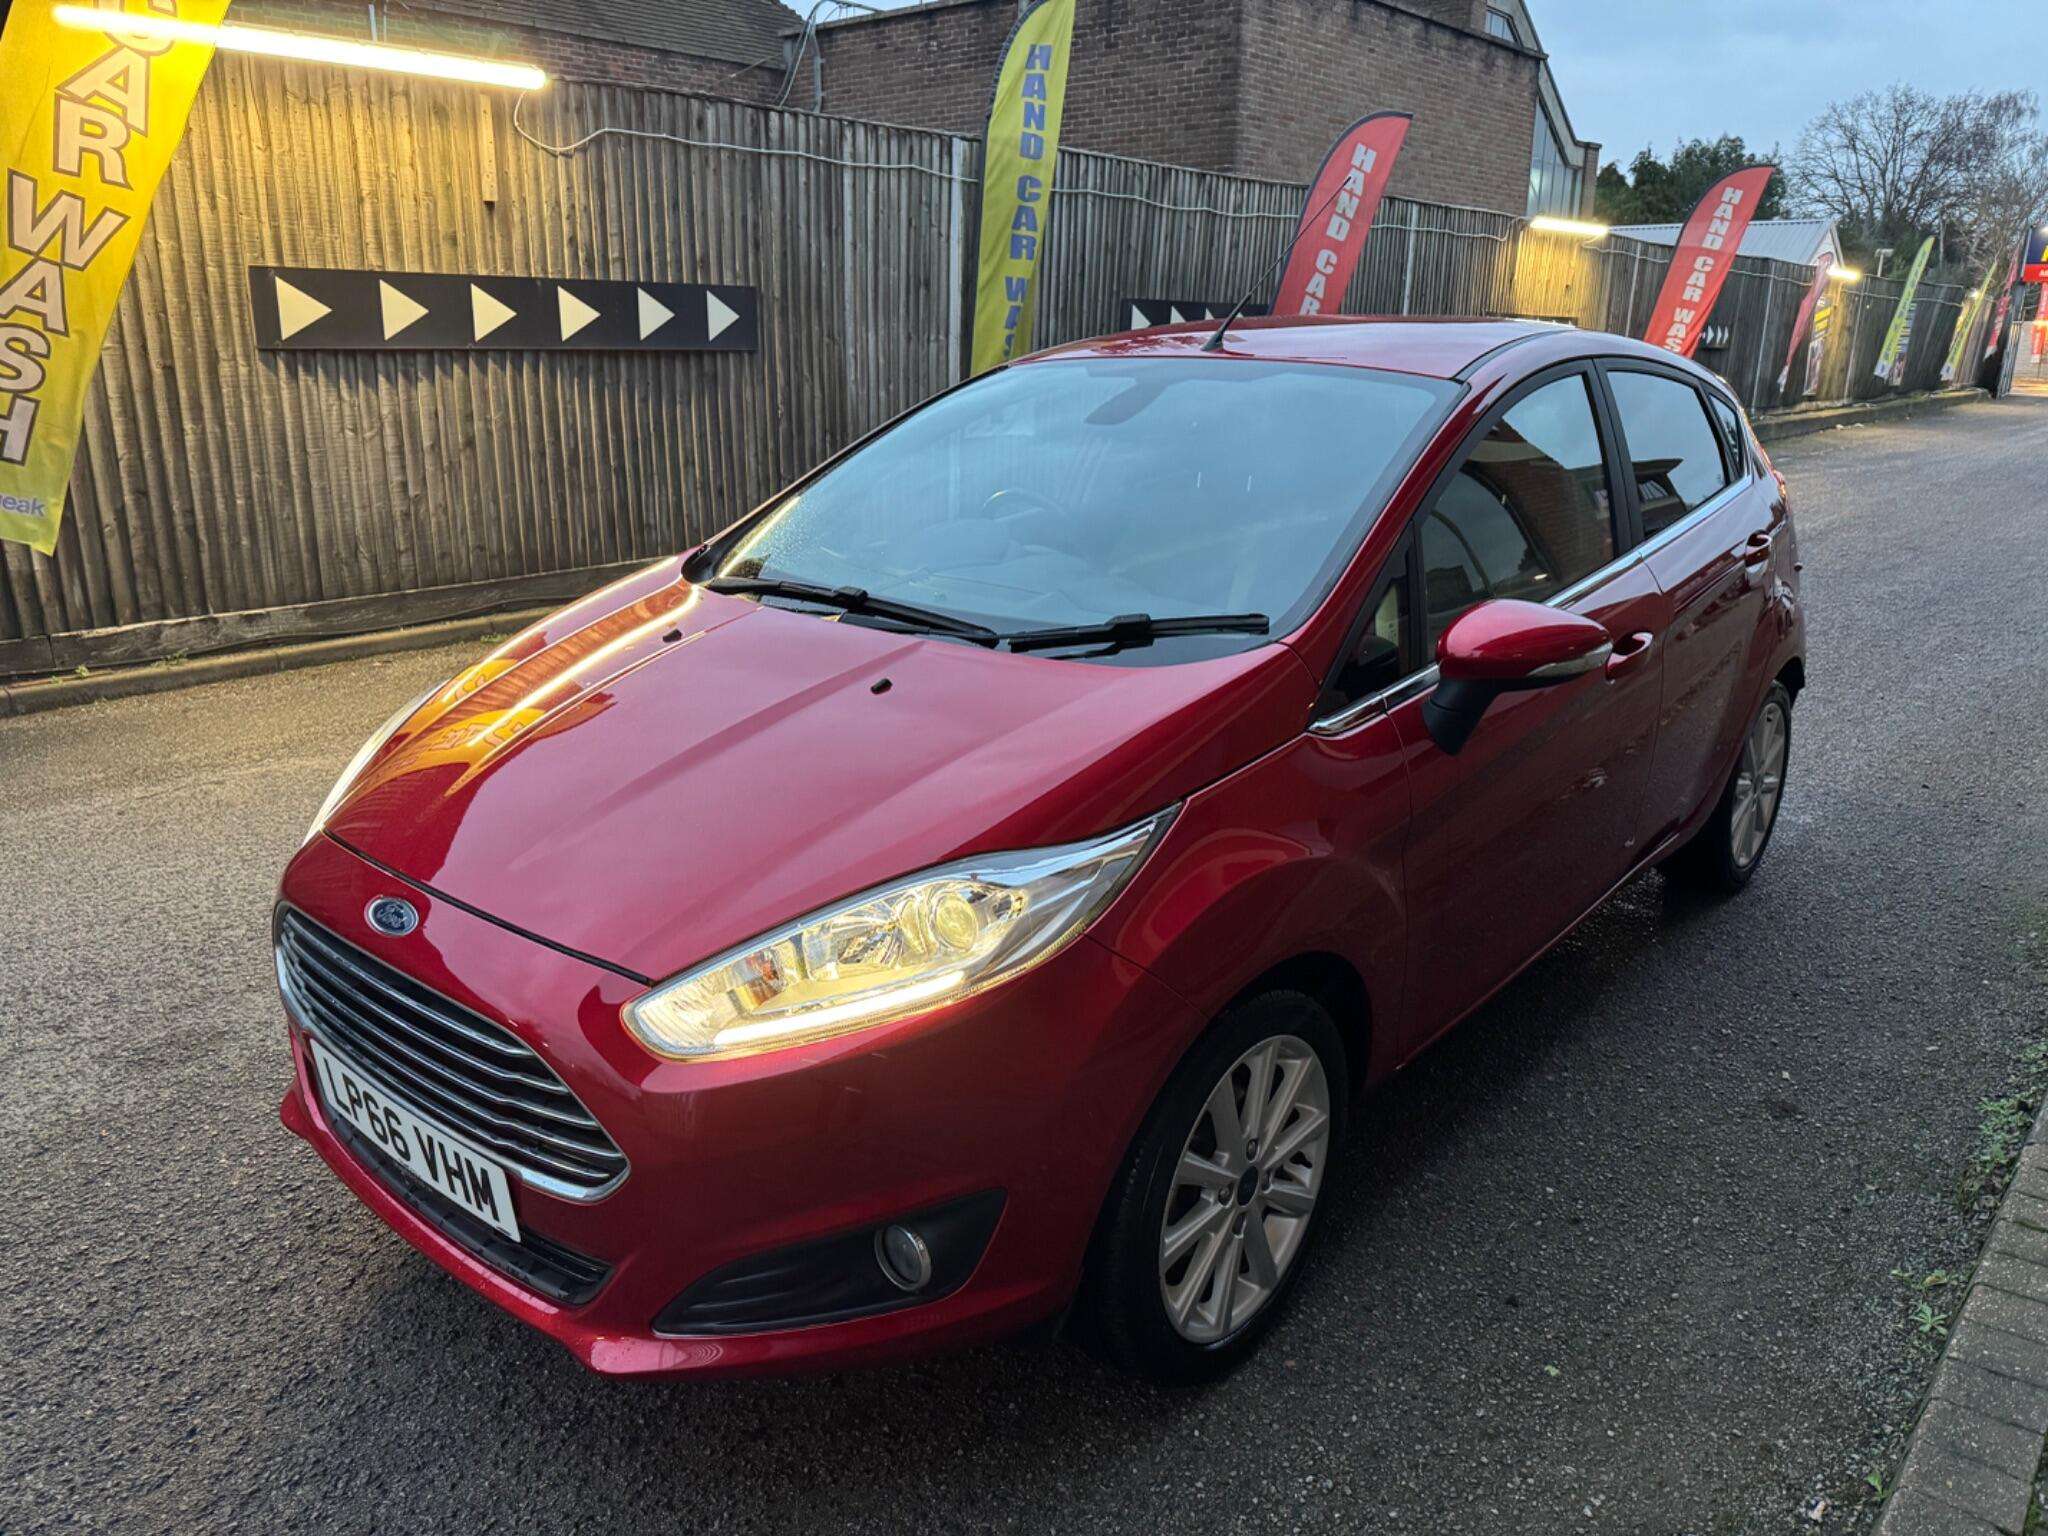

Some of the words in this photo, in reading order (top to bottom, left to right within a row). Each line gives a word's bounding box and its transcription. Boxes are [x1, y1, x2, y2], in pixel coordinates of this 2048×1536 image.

[1019, 44, 1052, 160] HAND
[1009, 175, 1041, 261] CAR
[1326, 142, 1377, 241] HAND
[1702, 187, 1744, 250] HAND
[1300, 249, 1338, 316] CAR
[1682, 256, 1714, 302] CAR
[0, 495, 45, 517] eak
[323, 1057, 410, 1161] LP66
[413, 1125, 500, 1222] VHM
